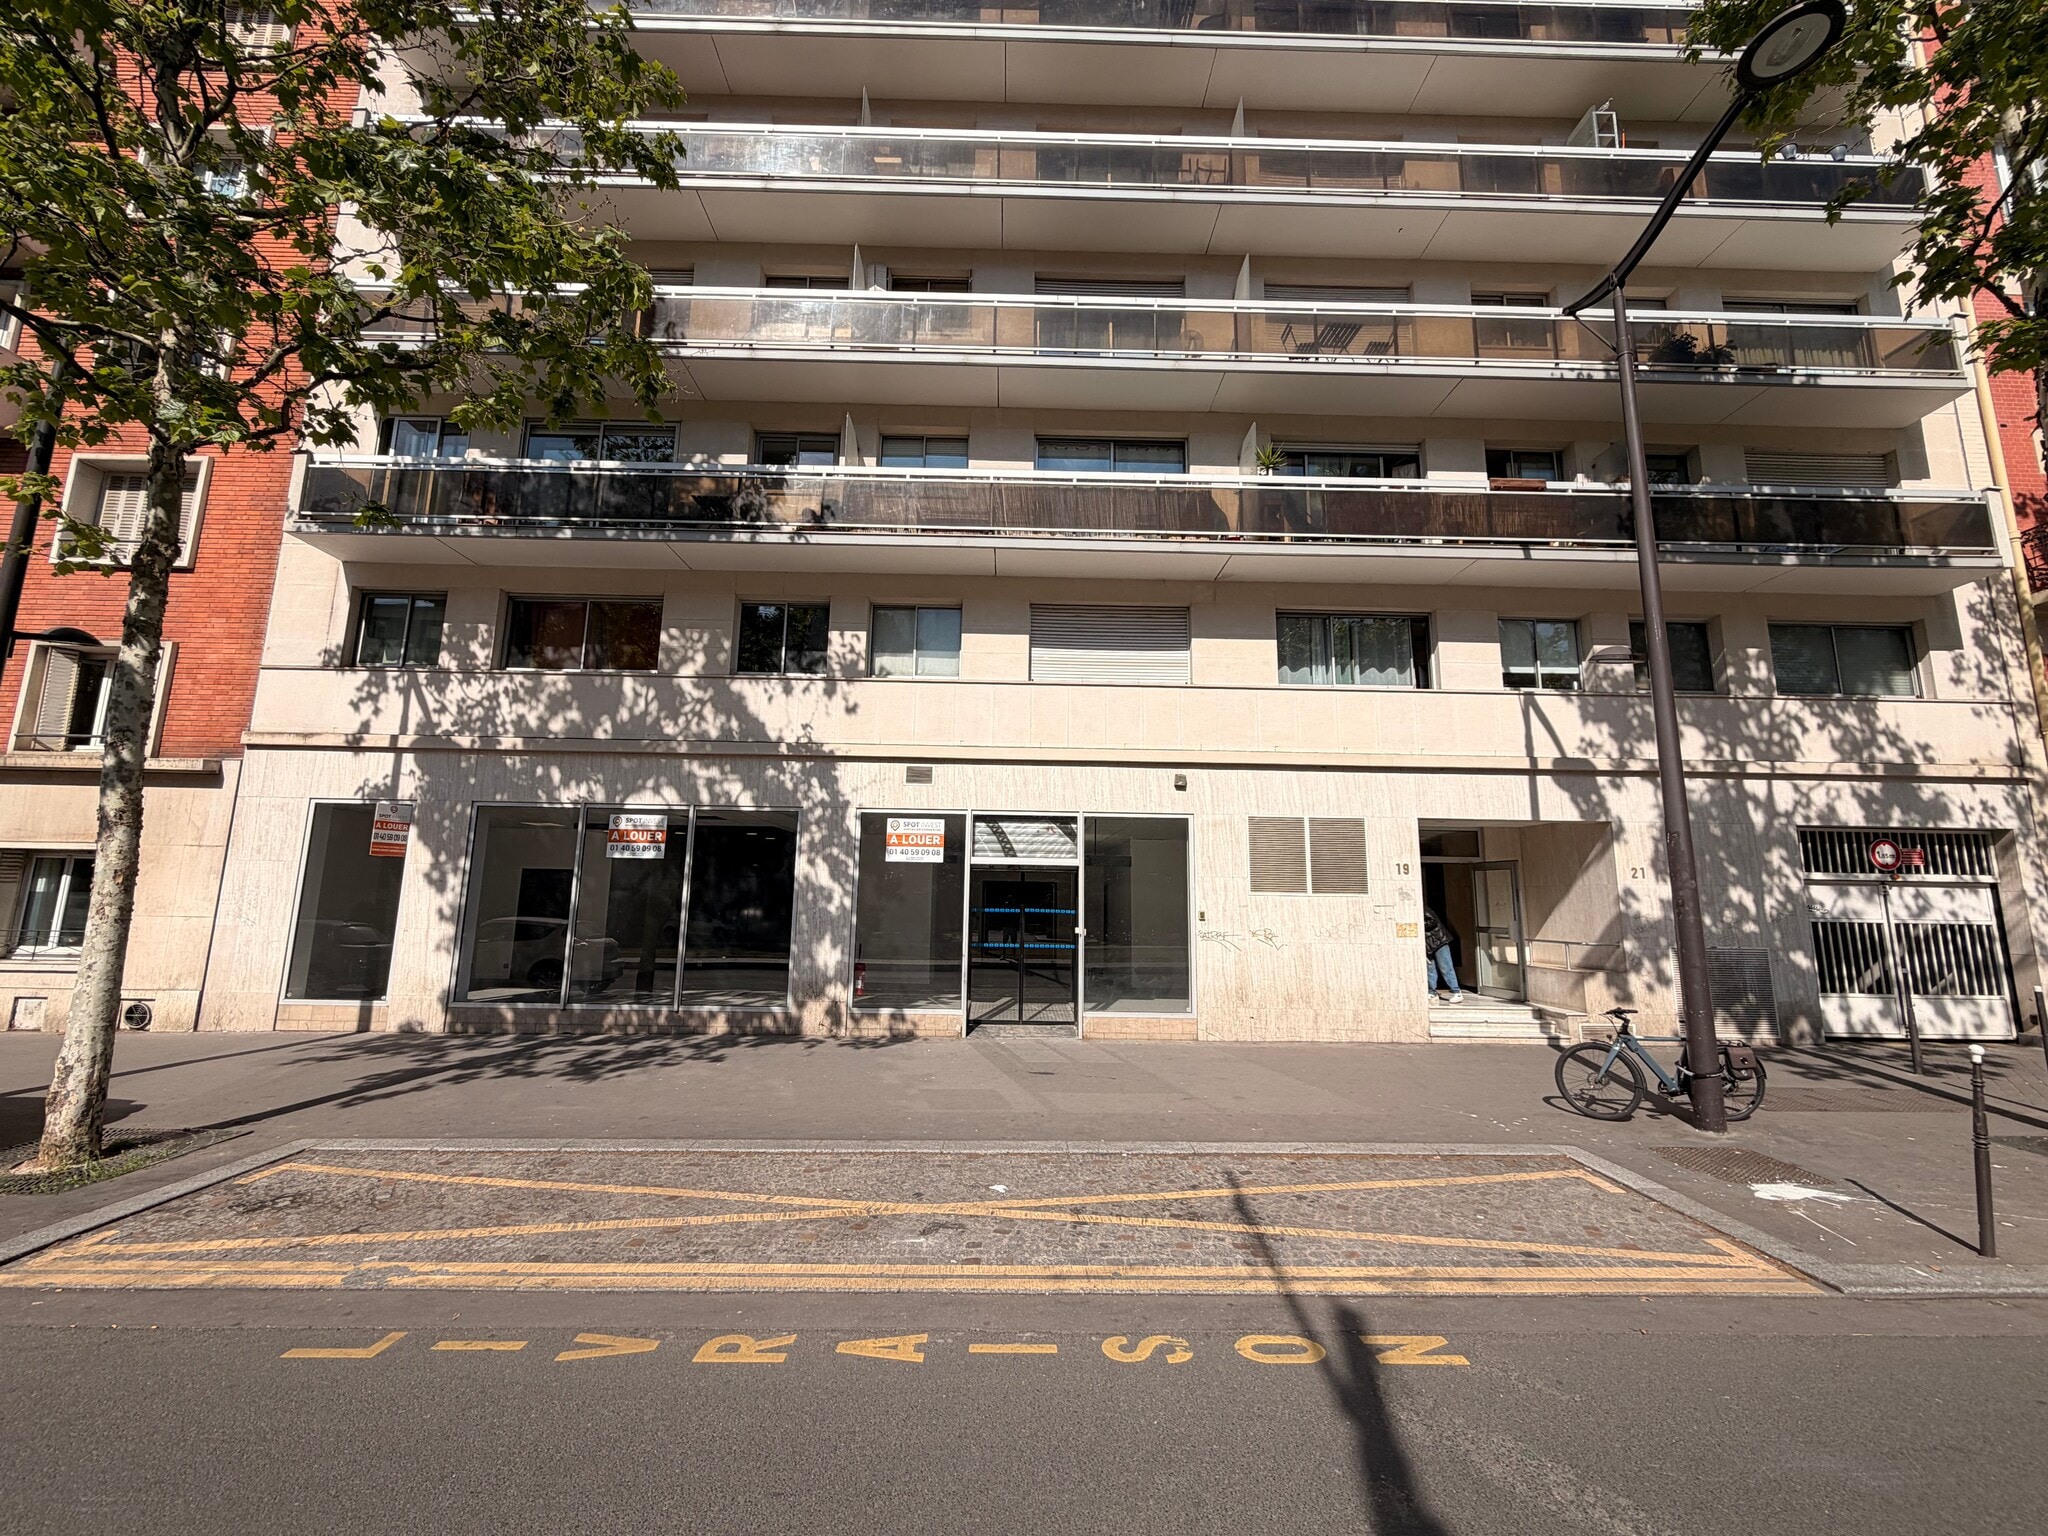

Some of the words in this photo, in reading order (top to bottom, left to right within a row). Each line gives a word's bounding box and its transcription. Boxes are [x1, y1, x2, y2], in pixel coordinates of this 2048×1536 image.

[383, 823, 409, 831] LOUER
[611, 830, 620, 840] A
[623, 830, 663, 841] LOUER
[890, 834, 898, 844] A
[902, 834, 940, 845] LOUER
[620, 844, 630, 852] 40
[899, 848, 909, 856] 40
[910, 848, 920, 856] 59
[921, 848, 930, 856] 09
[1395, 863, 1409, 875] 19
[1631, 867, 1645, 879] 21
